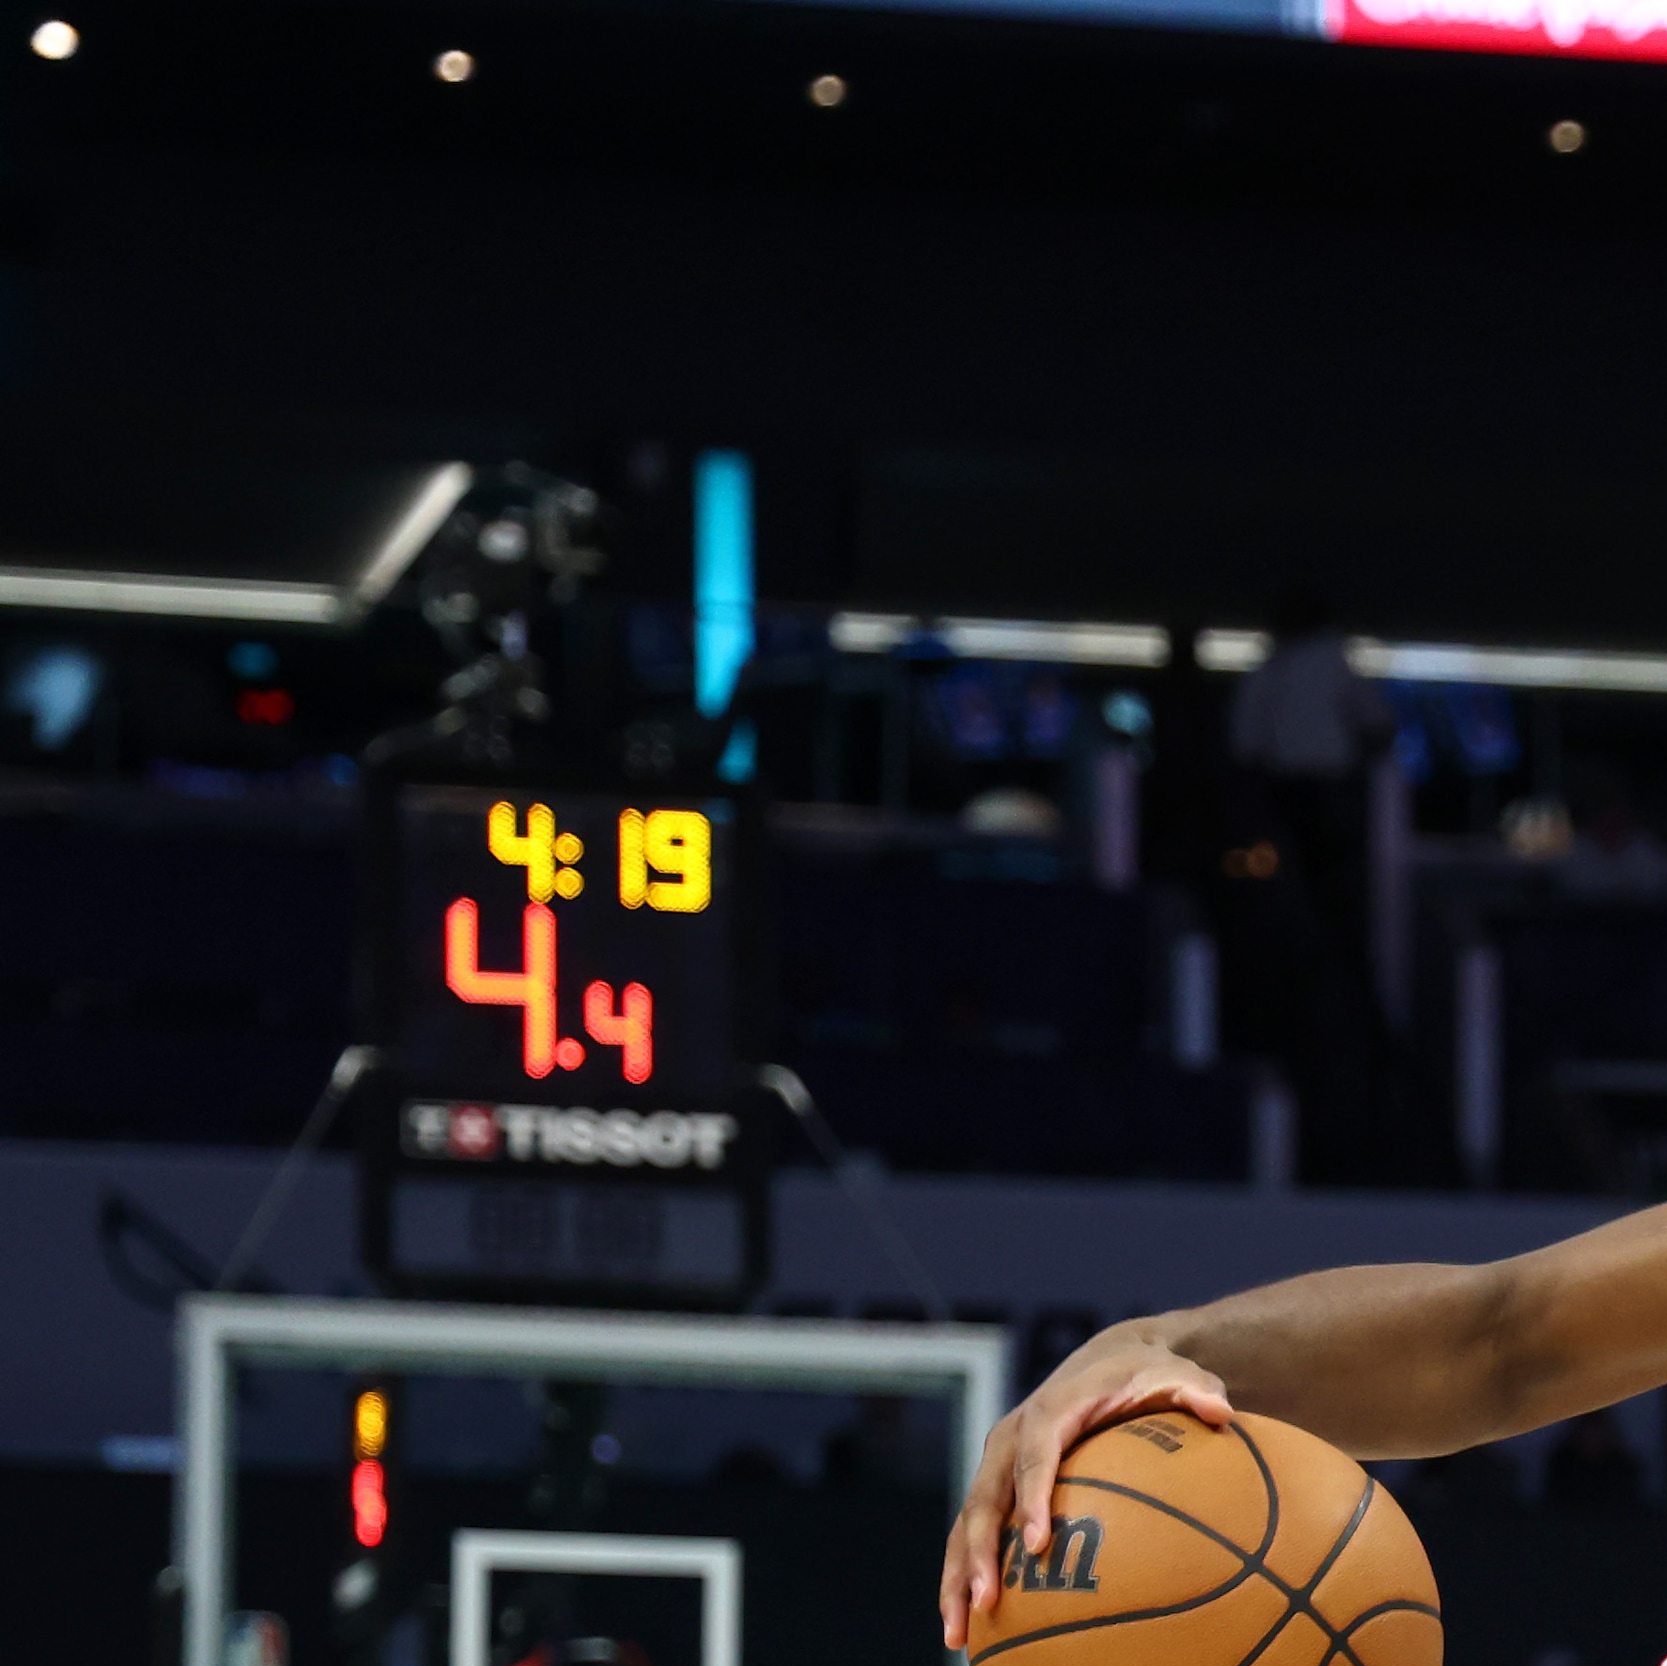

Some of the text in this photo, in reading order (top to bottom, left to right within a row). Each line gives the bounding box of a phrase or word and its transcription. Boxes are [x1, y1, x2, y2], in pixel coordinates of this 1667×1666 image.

[488, 801, 711, 913] 4:19
[445, 897, 652, 1084] 4.4
[501, 1104, 738, 1170] TISSOT
